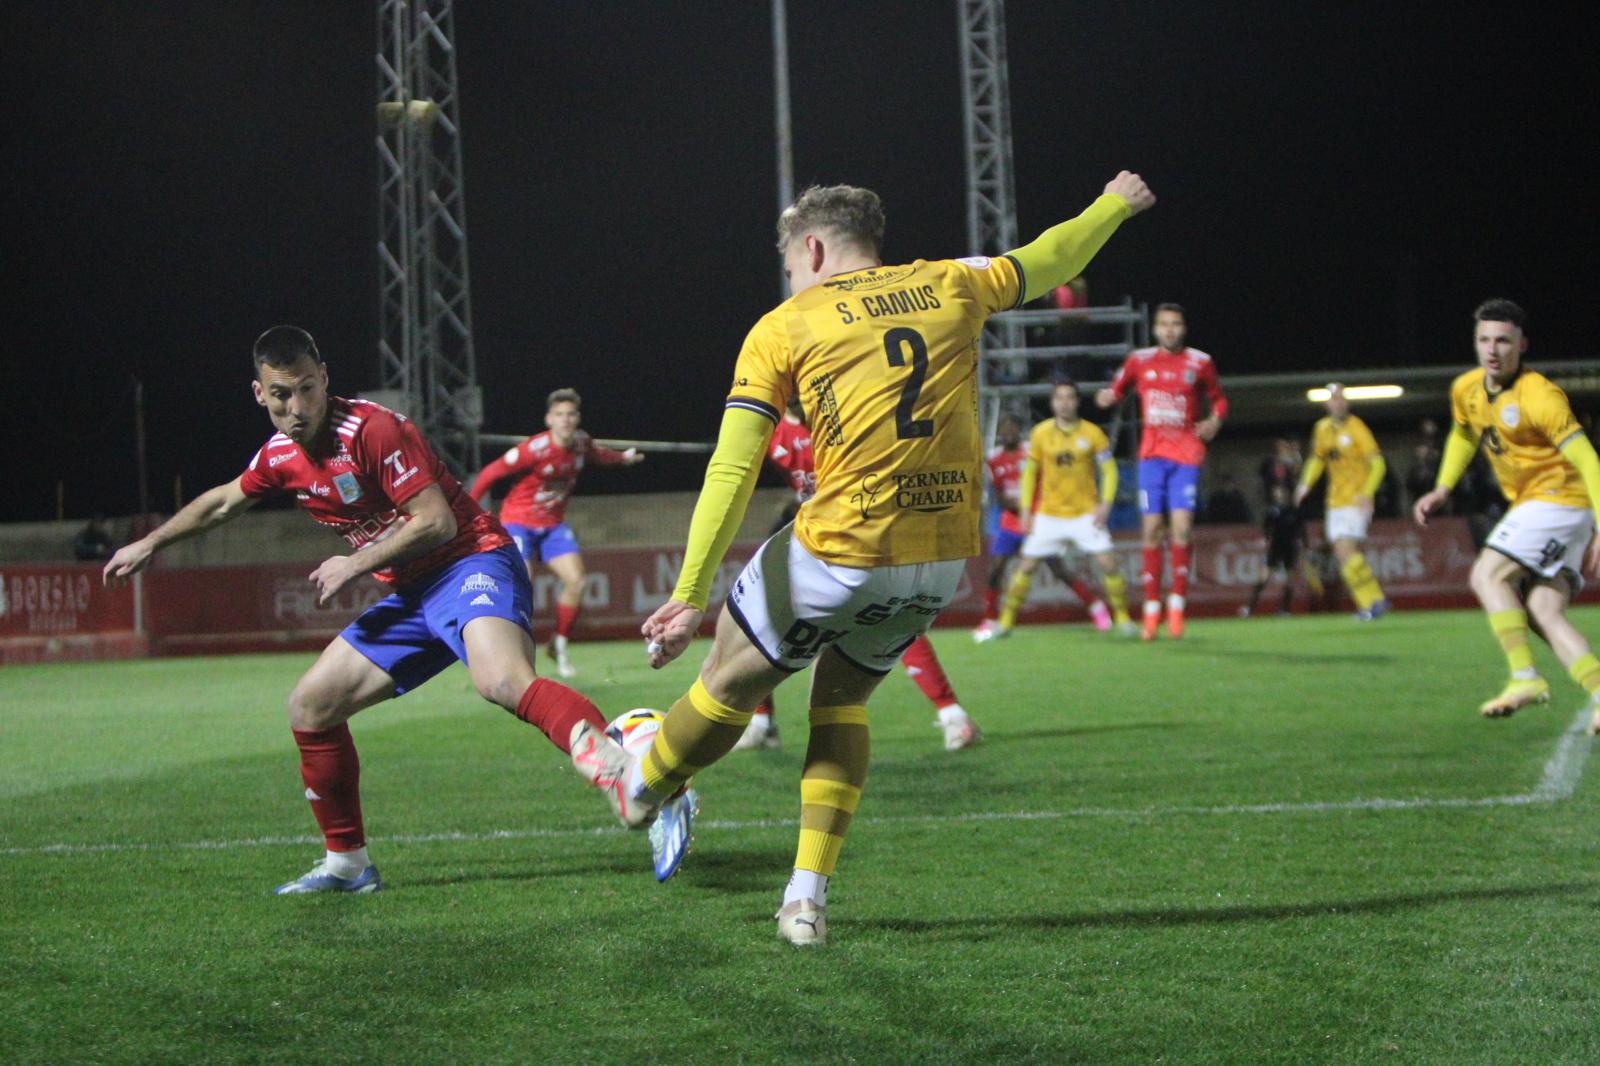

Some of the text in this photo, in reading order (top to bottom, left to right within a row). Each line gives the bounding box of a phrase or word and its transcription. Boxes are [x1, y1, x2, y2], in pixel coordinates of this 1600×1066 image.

[835, 284, 942, 325] S. CAMUS
[883, 326, 934, 440] 2
[892, 469, 968, 490] TERNERA
[895, 488, 964, 509] CHARRA
